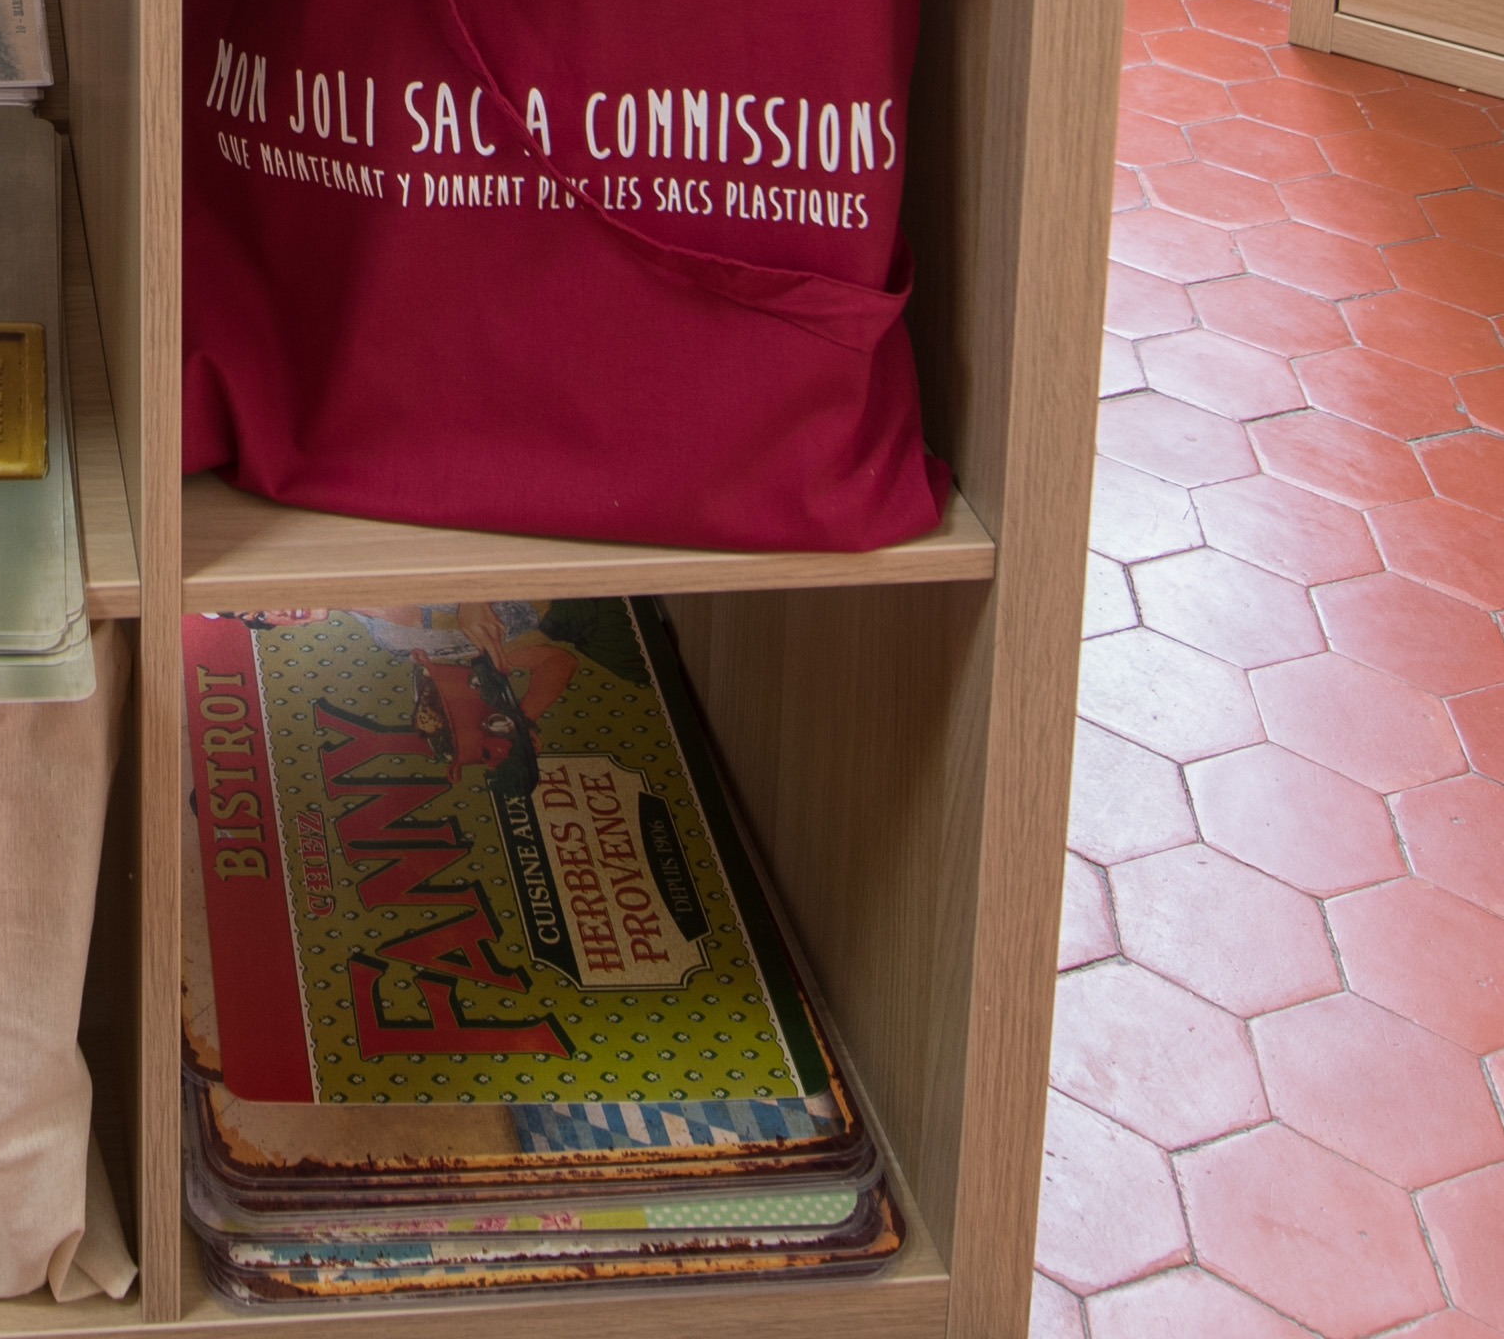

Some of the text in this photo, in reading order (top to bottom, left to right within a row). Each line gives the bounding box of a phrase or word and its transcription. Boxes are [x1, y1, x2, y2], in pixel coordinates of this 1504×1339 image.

[206, 36, 897, 175] MON JOLI SAC A COMMISSIONS
[217, 130, 251, 173] QUE
[260, 142, 386, 201] MAINTENANT
[396, 173, 413, 209] Y
[423, 174, 525, 211] DONNENT
[602, 176, 643, 213] LES
[653, 178, 715, 218] SACS
[724, 182, 872, 231] PLASTIQUES
[195, 665, 268, 883] BISTROT
[293, 810, 335, 918] CHEZ
[316, 698, 576, 1062] FANNY
[504, 792, 561, 948] CUISINE AUX
[541, 763, 626, 975] HERBES DE
[579, 770, 671, 965] PROVENCE
[649, 818, 696, 919] DEPUIS 1906
